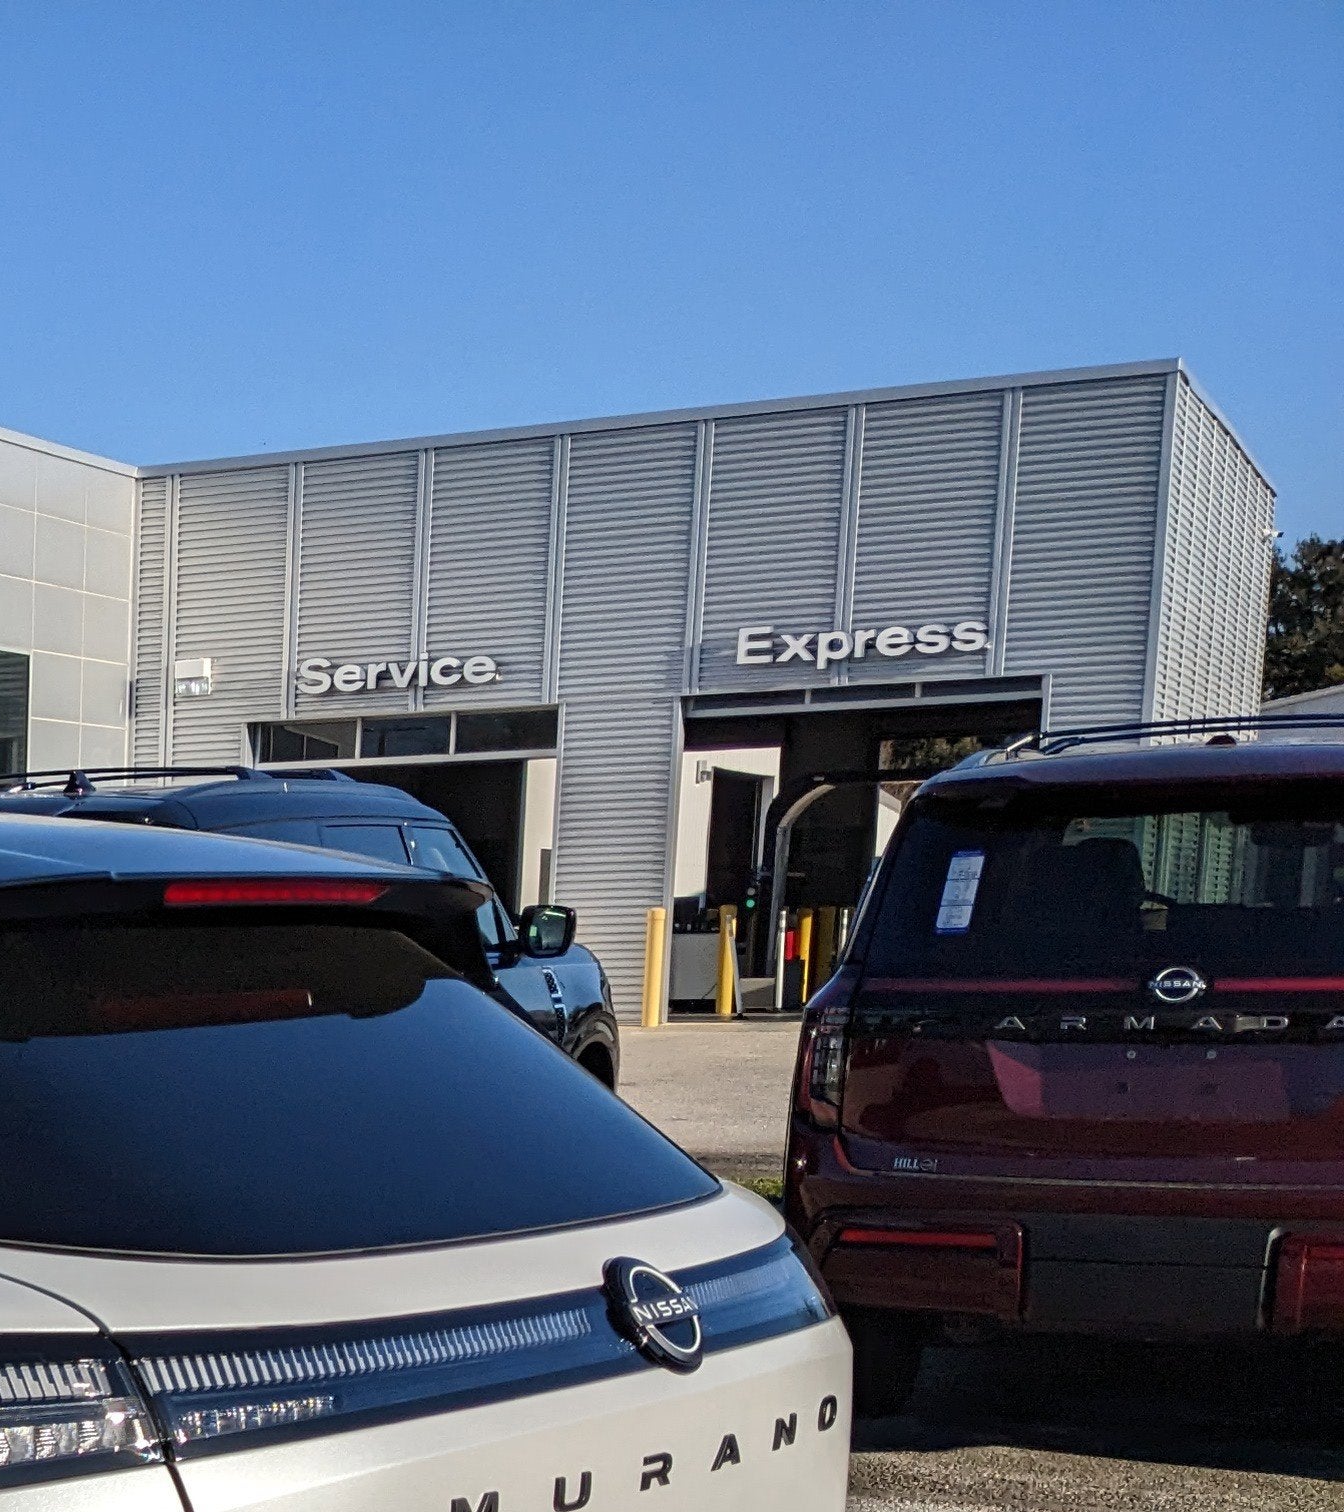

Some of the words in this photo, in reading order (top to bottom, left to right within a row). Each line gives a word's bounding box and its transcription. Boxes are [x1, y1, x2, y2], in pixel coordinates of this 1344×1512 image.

[736, 620, 989, 670] Express
[296, 652, 498, 694] Service
[995, 1014, 1344, 1031] ARMADA
